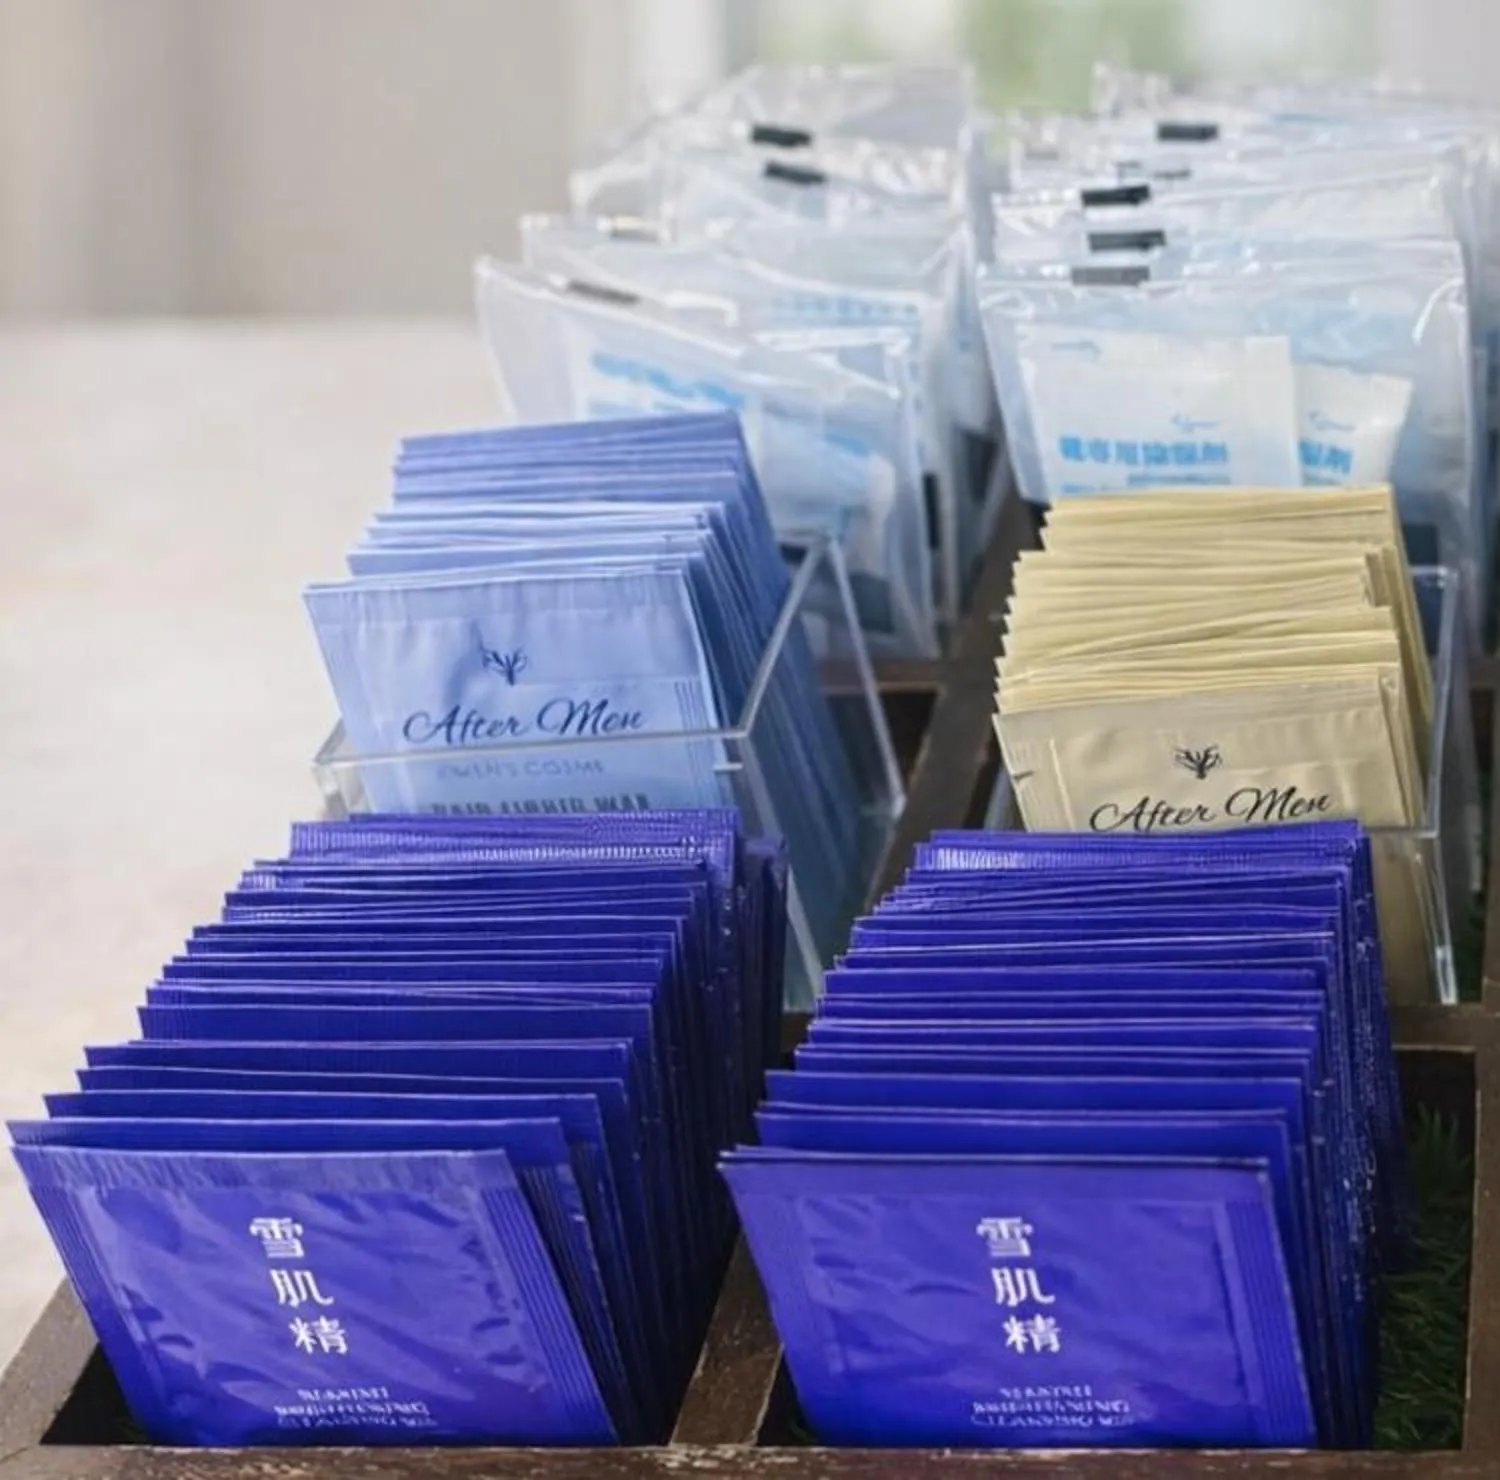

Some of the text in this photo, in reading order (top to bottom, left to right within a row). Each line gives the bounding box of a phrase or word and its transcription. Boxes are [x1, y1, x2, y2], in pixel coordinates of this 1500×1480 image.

[402, 697, 645, 745] After Men
[1089, 786, 1334, 832] After Men
[248, 1216, 349, 1355] 雪肌精
[975, 1216, 1061, 1354] 雪肌精
